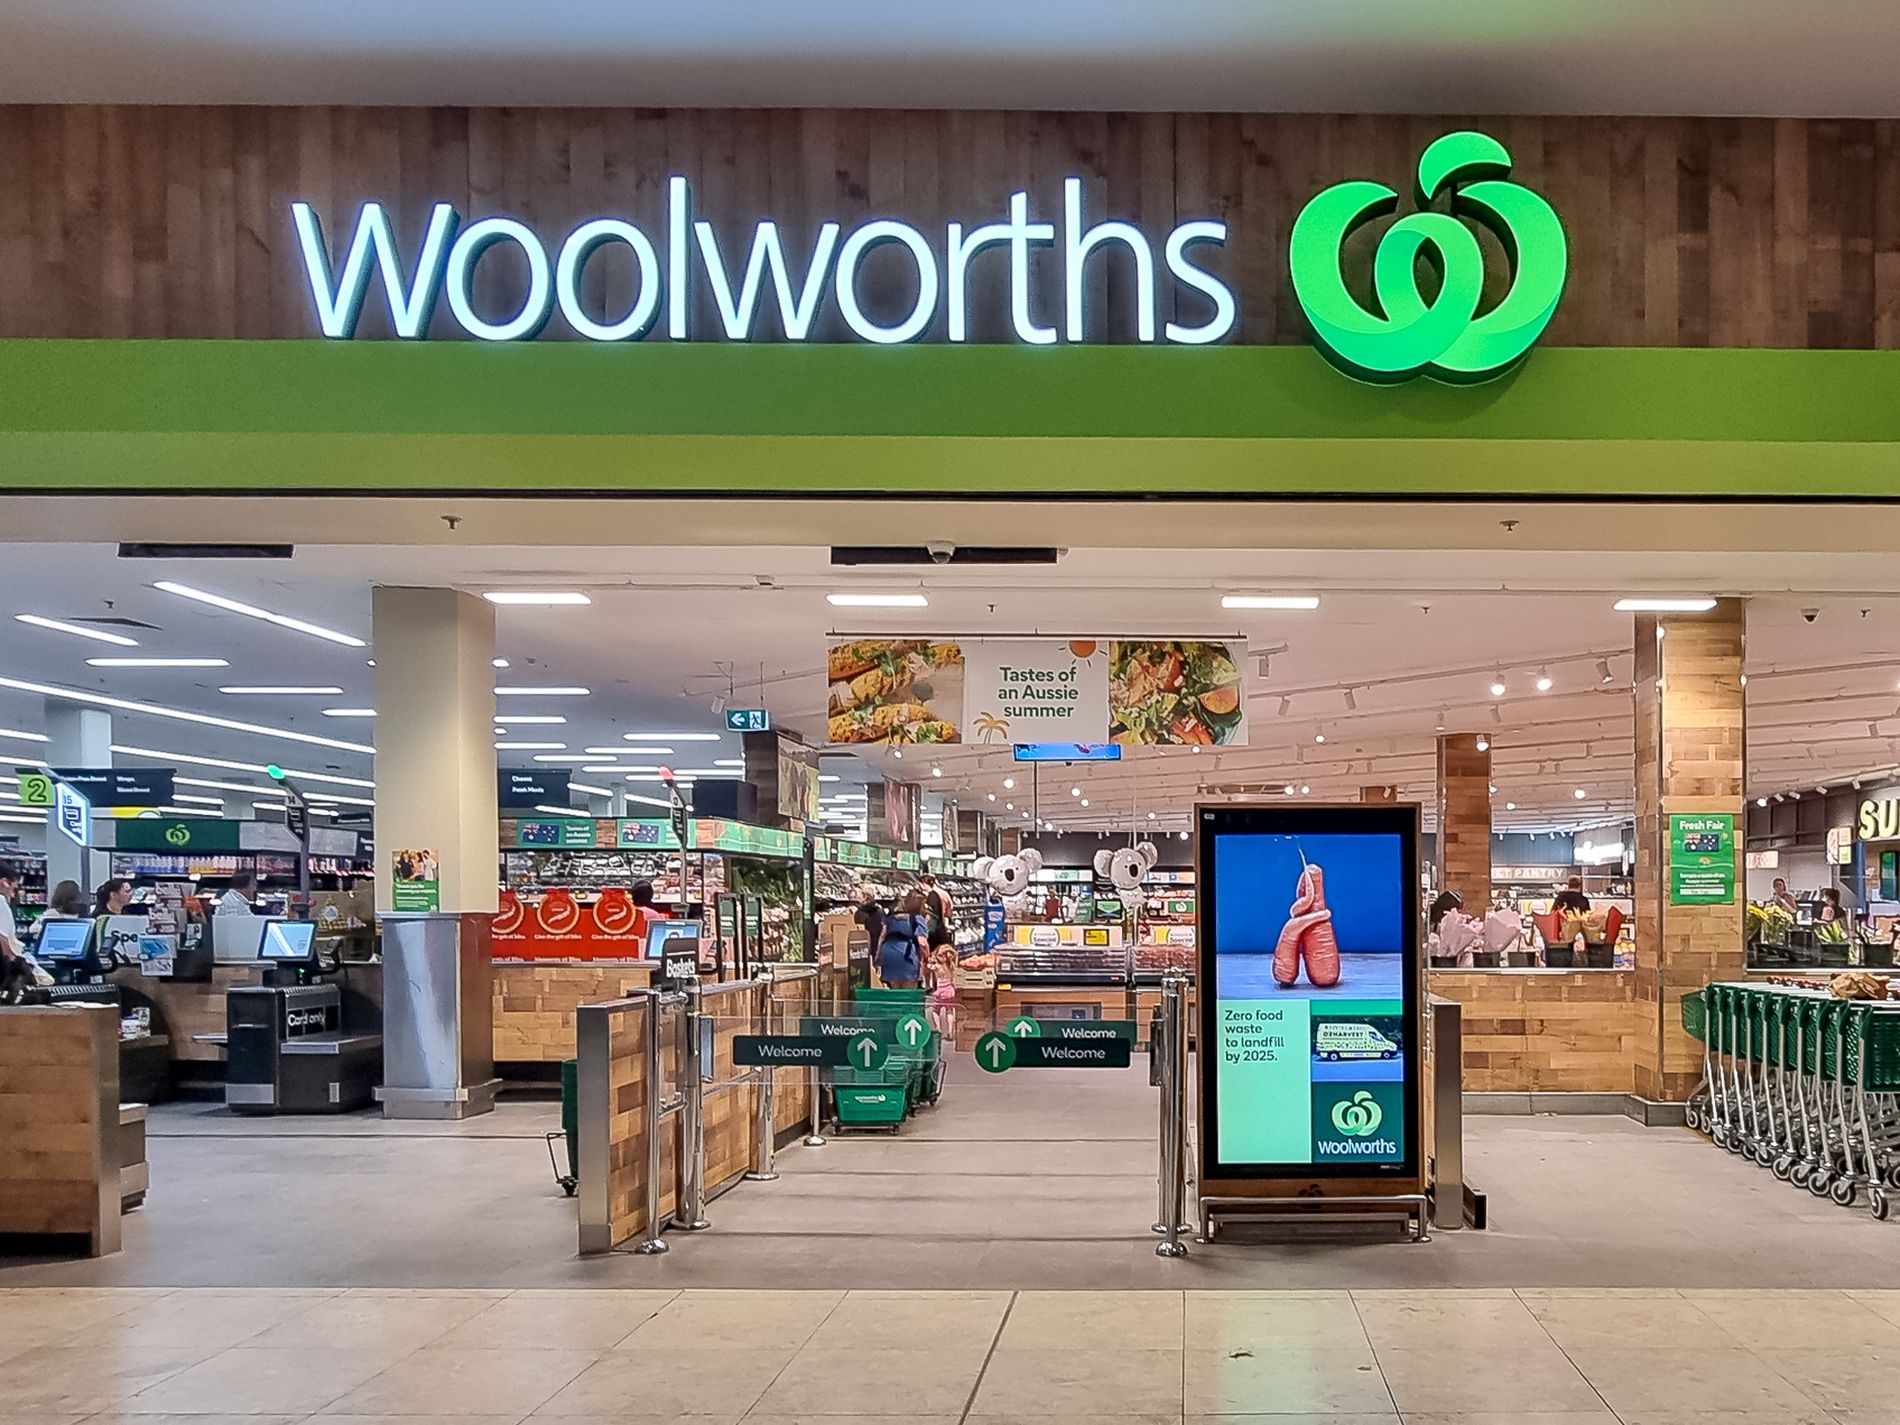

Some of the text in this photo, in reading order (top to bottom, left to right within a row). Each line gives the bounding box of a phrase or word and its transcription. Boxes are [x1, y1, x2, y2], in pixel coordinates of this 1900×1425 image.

[291, 177, 1236, 344] Woolworths
[999, 667, 1076, 681] Tastes of
[998, 685, 1079, 700] an Aussie
[1004, 706, 1074, 717] summer
[27, 778, 47, 802] 2
[63, 795, 73, 804] 15
[1680, 820, 1725, 830] Fresh Fair
[1513, 868, 1563, 878] PANTRY
[666, 960, 696, 978] Baskets
[287, 1014, 309, 1026] Card
[1225, 1009, 1283, 1021] Zero food
[1061, 1027, 1117, 1038] Welcome
[1225, 1024, 1263, 1034] waste
[1226, 1036, 1285, 1047] to landfill
[758, 1045, 822, 1057] Welcome
[1041, 1046, 1106, 1058] Welcome
[1226, 1050, 1278, 1064] by 2025.
[1317, 1139, 1397, 1154] Woolworths
